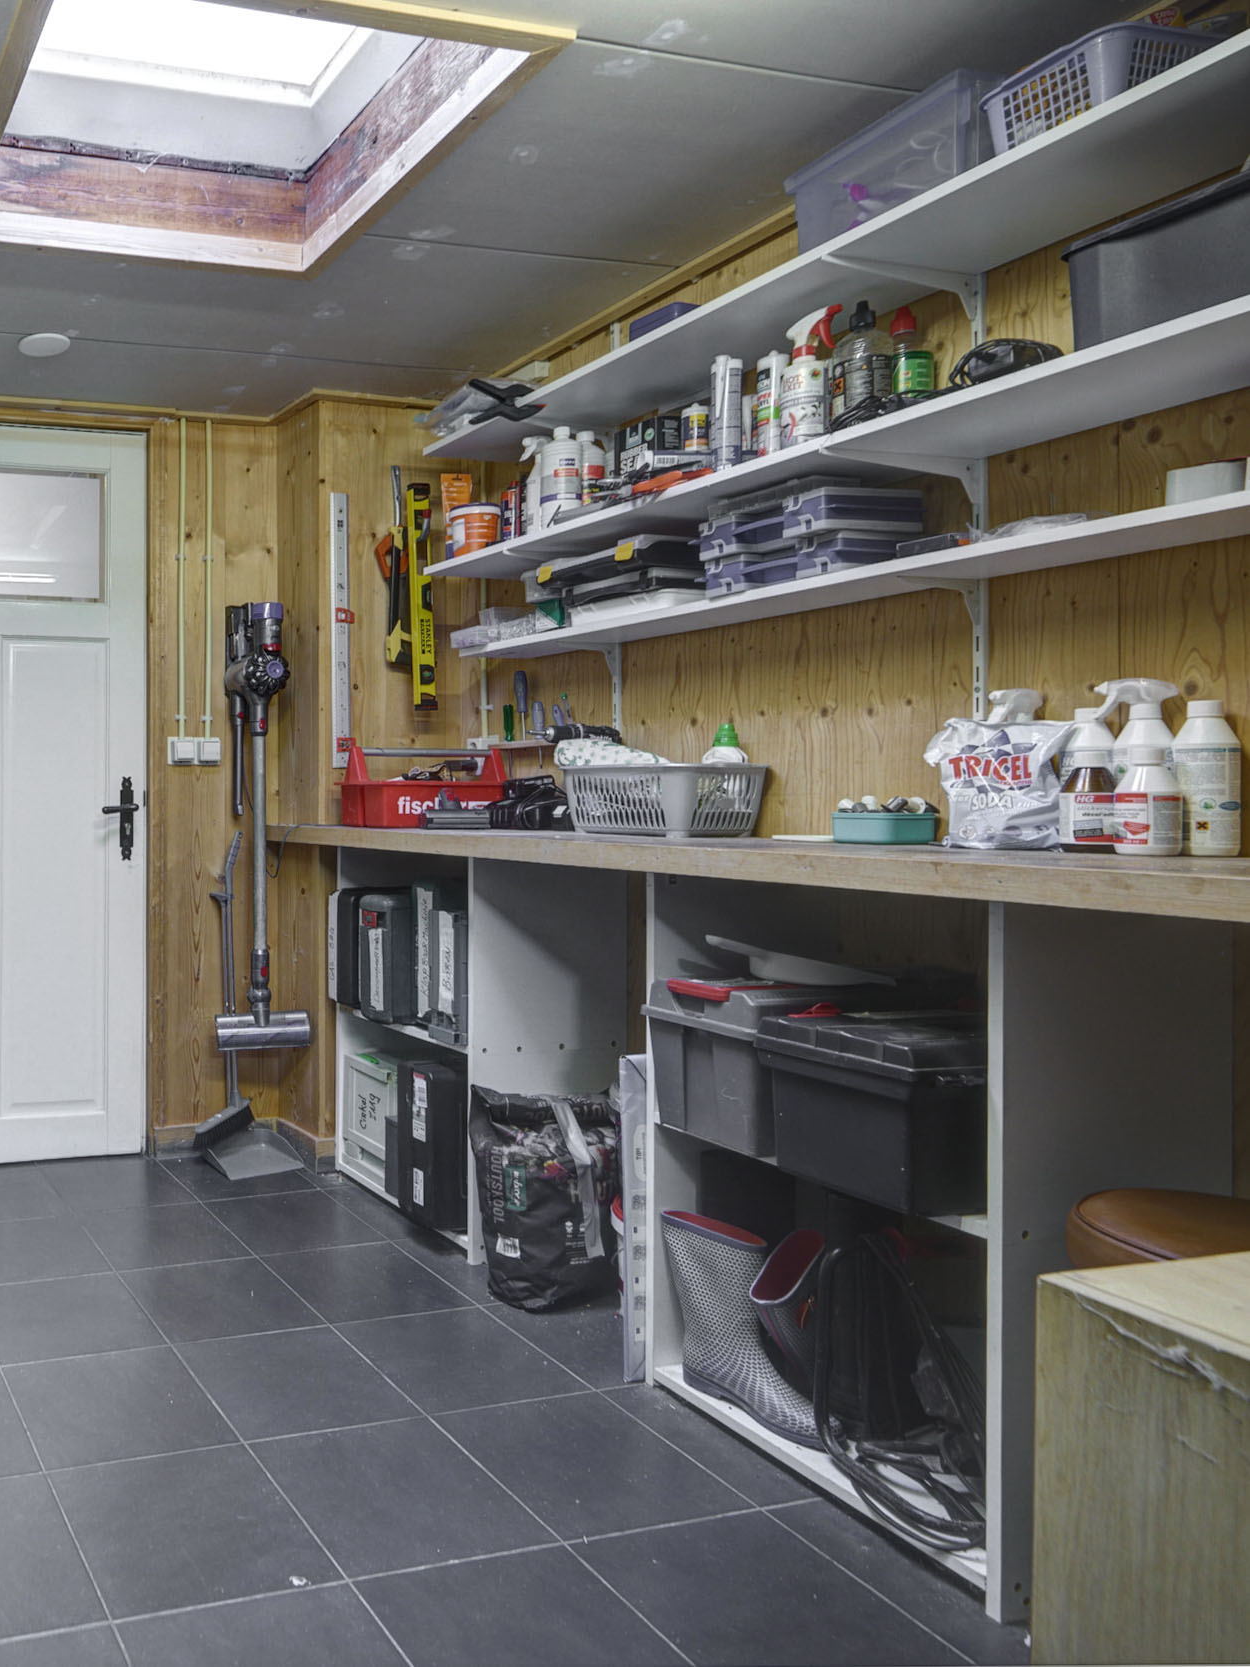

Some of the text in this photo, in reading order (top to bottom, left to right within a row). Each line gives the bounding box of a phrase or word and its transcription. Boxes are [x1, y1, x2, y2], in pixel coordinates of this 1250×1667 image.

[425, 618, 433, 655] STANLEY
[948, 754, 1033, 781] TRICEL
[970, 792, 1014, 812] SODA
[1075, 795, 1096, 804] HG
[489, 1145, 506, 1224] HOUTSKOOL
